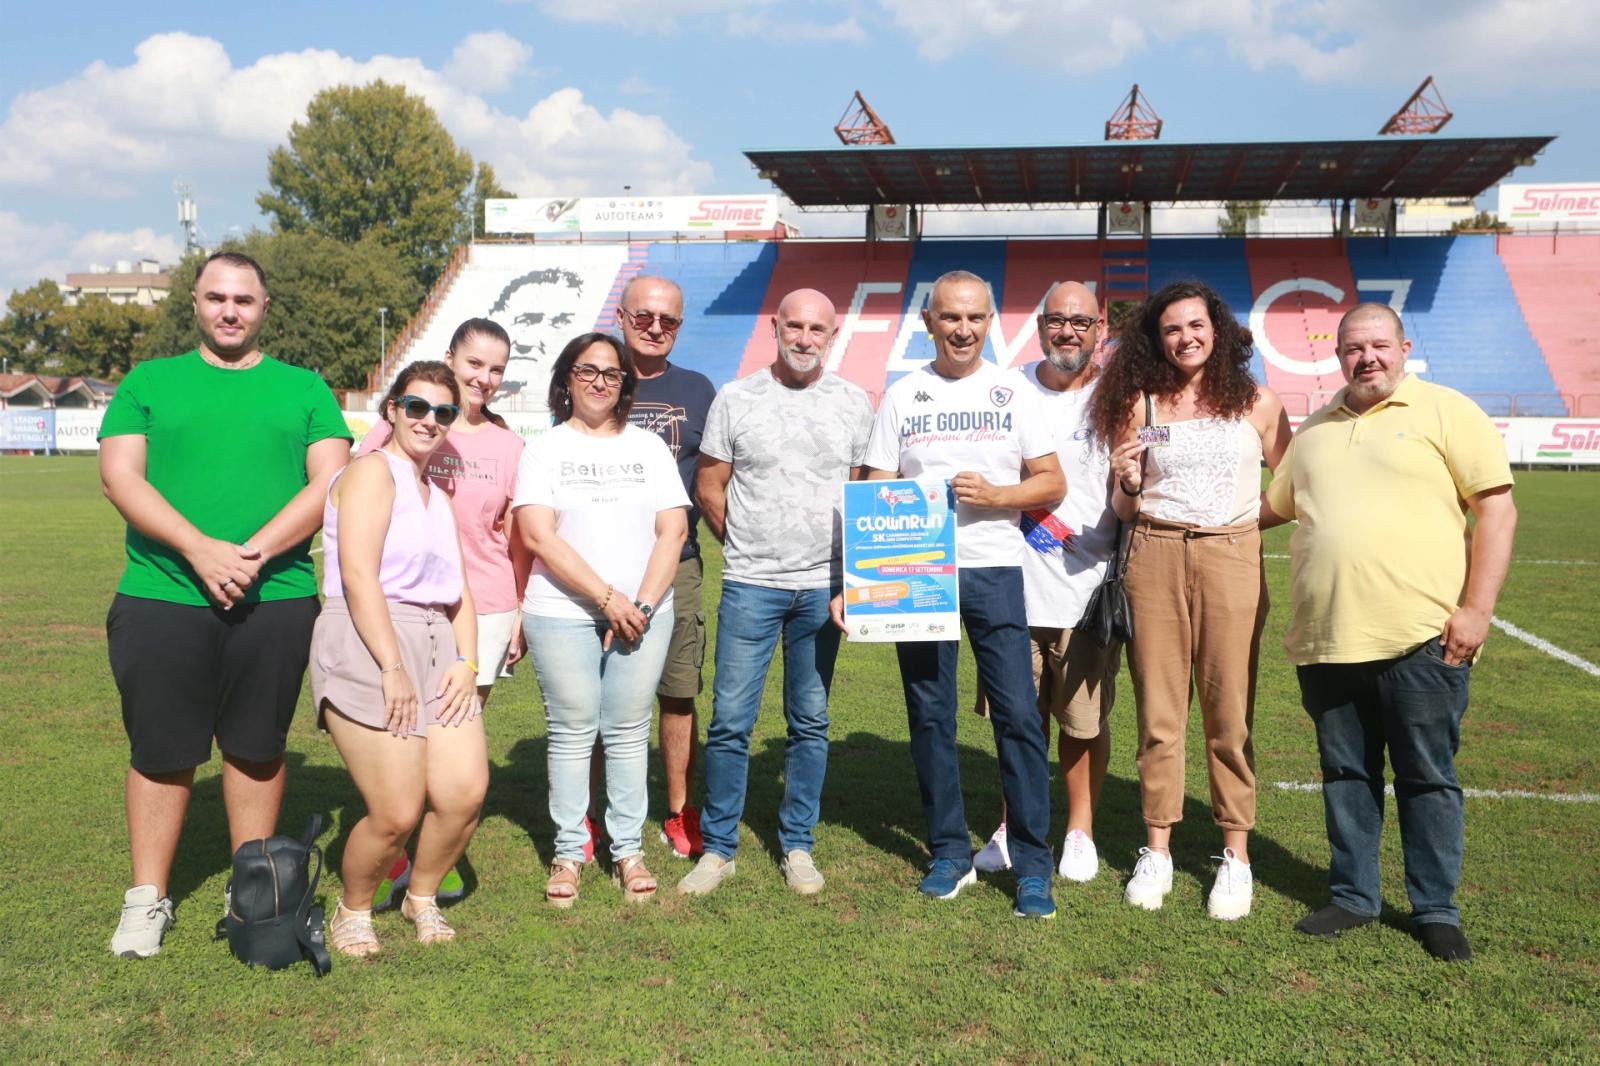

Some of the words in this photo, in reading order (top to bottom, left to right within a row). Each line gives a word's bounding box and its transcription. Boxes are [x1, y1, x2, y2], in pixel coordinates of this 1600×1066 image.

[1512, 188, 1600, 211] Solmec
[595, 212, 654, 221] AUTOTEAM
[657, 211, 663, 220] 9
[689, 199, 767, 221] Solmec
[901, 414, 932, 437] CHE
[936, 411, 1012, 433] GODUR14
[905, 432, 960, 448] Campioni
[965, 427, 1008, 442] d'Italia
[429, 465, 449, 474] like
[442, 456, 480, 469] SHINE
[560, 461, 645, 477] Believe
[872, 533, 885, 542] 5K
[881, 565, 907, 573] DOMENICA
[914, 565, 943, 573] SETTEMBRE
